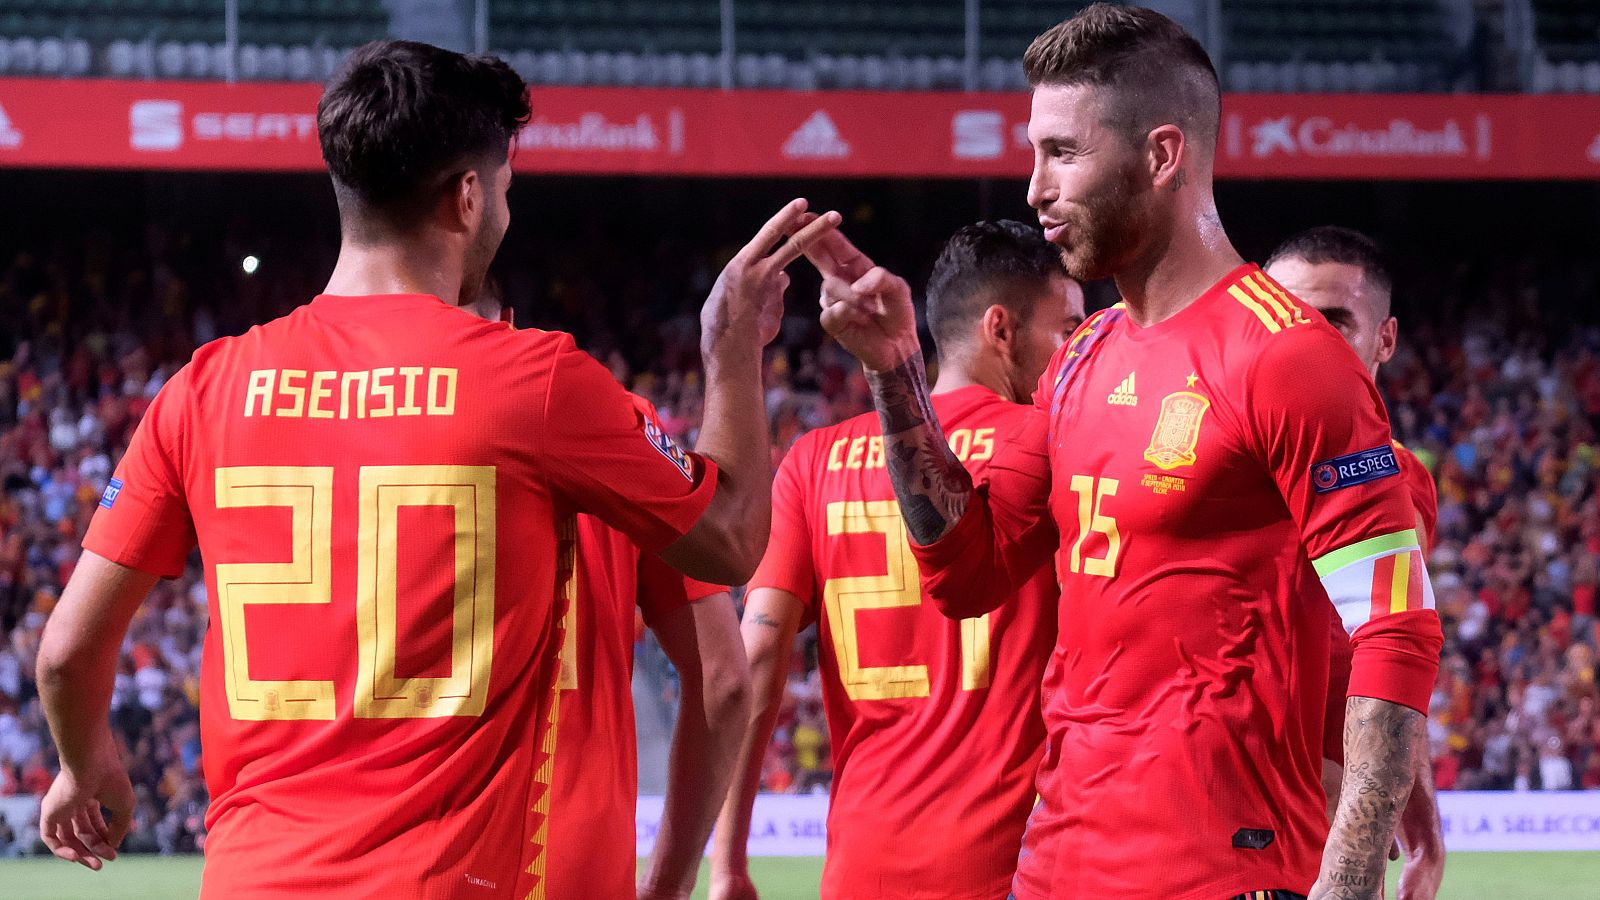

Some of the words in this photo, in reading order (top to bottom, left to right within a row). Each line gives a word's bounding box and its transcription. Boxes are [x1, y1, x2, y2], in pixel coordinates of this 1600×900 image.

[194, 113, 316, 138] SEAT
[519, 113, 660, 150] aixaBank
[1300, 117, 1466, 156] CaixaBank
[243, 366, 459, 420] ASENSIO
[1107, 392, 1138, 407] adidas
[827, 427, 996, 471] CEBOS
[1338, 453, 1395, 479] RESPECT
[1069, 474, 1121, 578] 15
[214, 465, 498, 721] 20
[1349, 761, 1388, 798] Sergio
